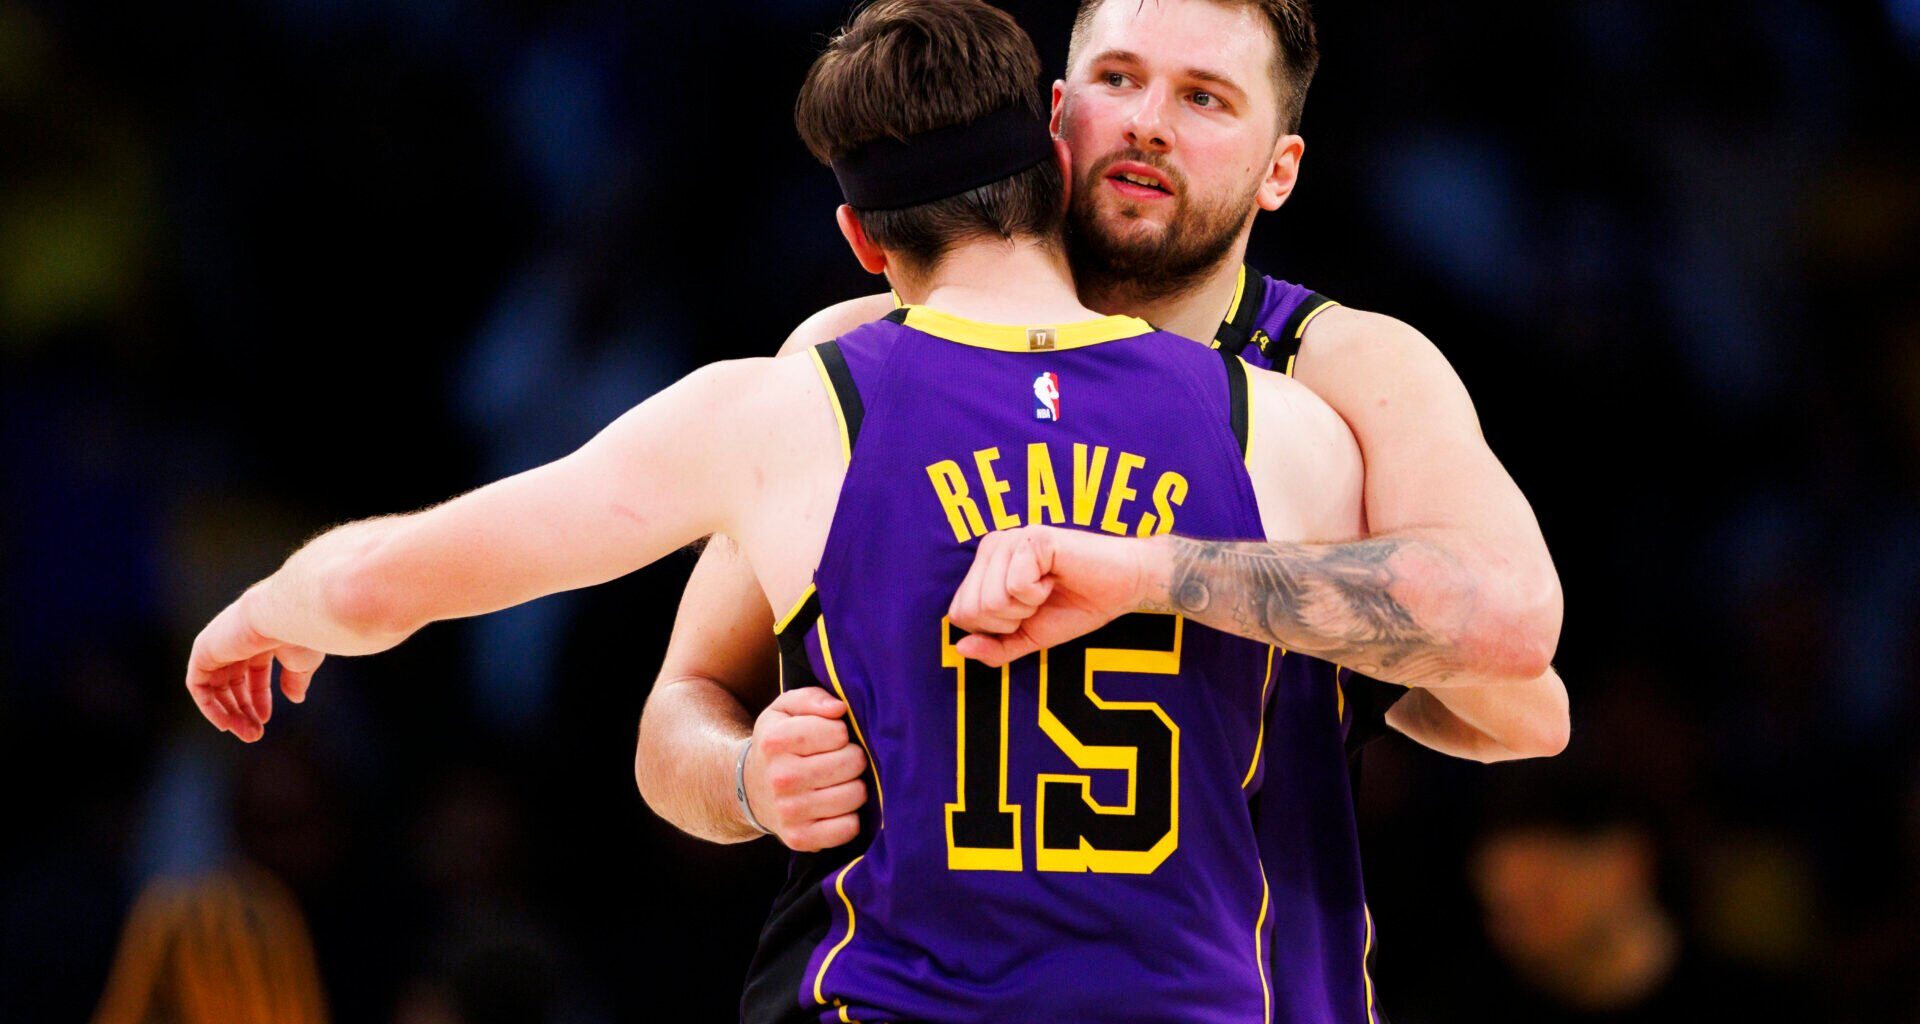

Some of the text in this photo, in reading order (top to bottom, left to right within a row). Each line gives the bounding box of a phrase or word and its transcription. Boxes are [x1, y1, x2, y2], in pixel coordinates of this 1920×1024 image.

[1035, 332, 1047, 346] 17
[925, 442, 1189, 543] REAVES
[941, 611, 1184, 875] 15
